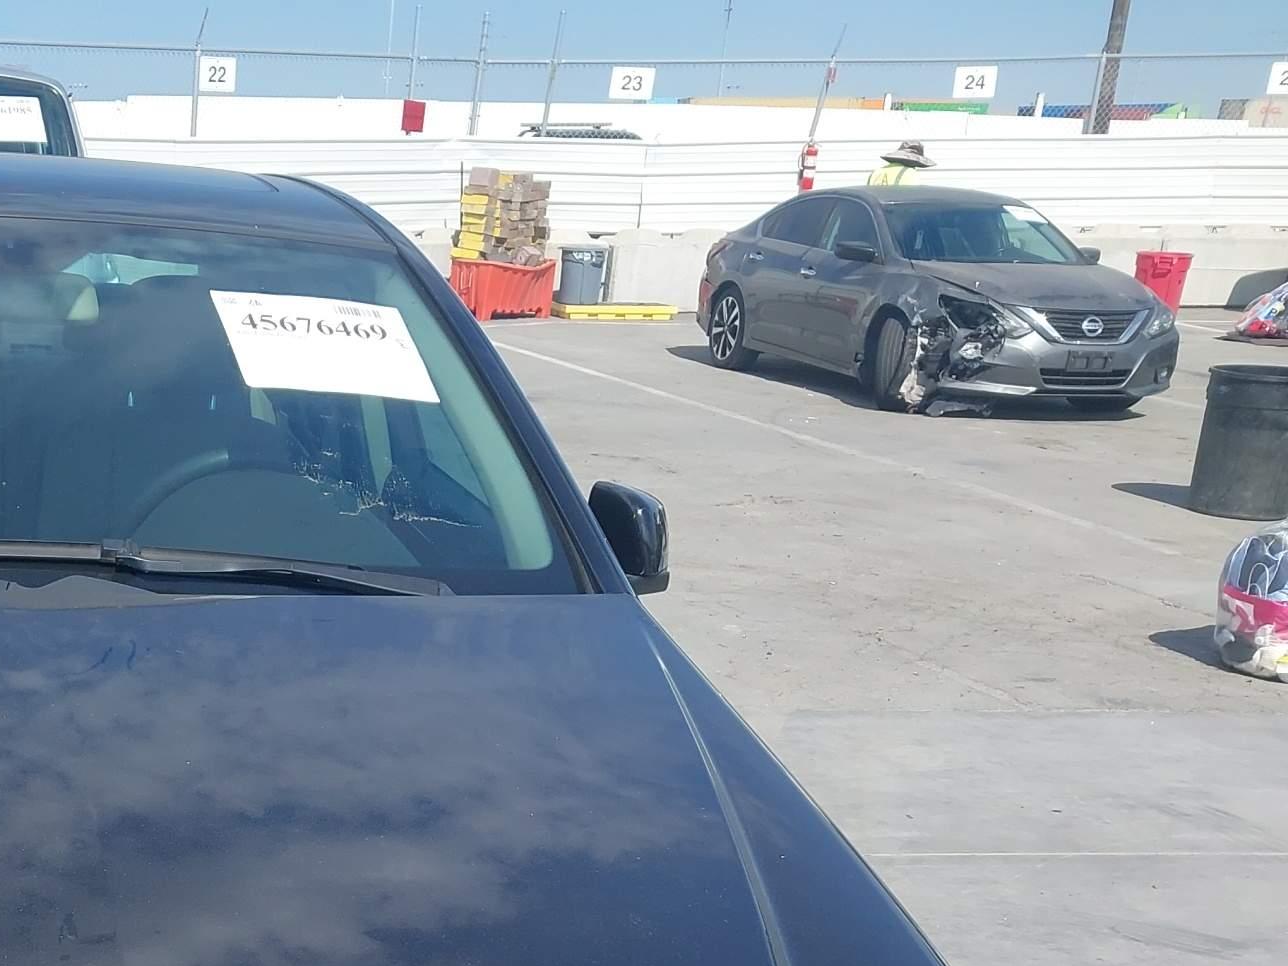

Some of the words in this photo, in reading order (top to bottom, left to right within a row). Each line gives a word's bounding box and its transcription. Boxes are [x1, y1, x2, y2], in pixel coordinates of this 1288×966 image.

[208, 65, 227, 83] 22
[964, 74, 985, 90] 24
[621, 75, 643, 91] 23
[240, 312, 388, 340] 45676469
